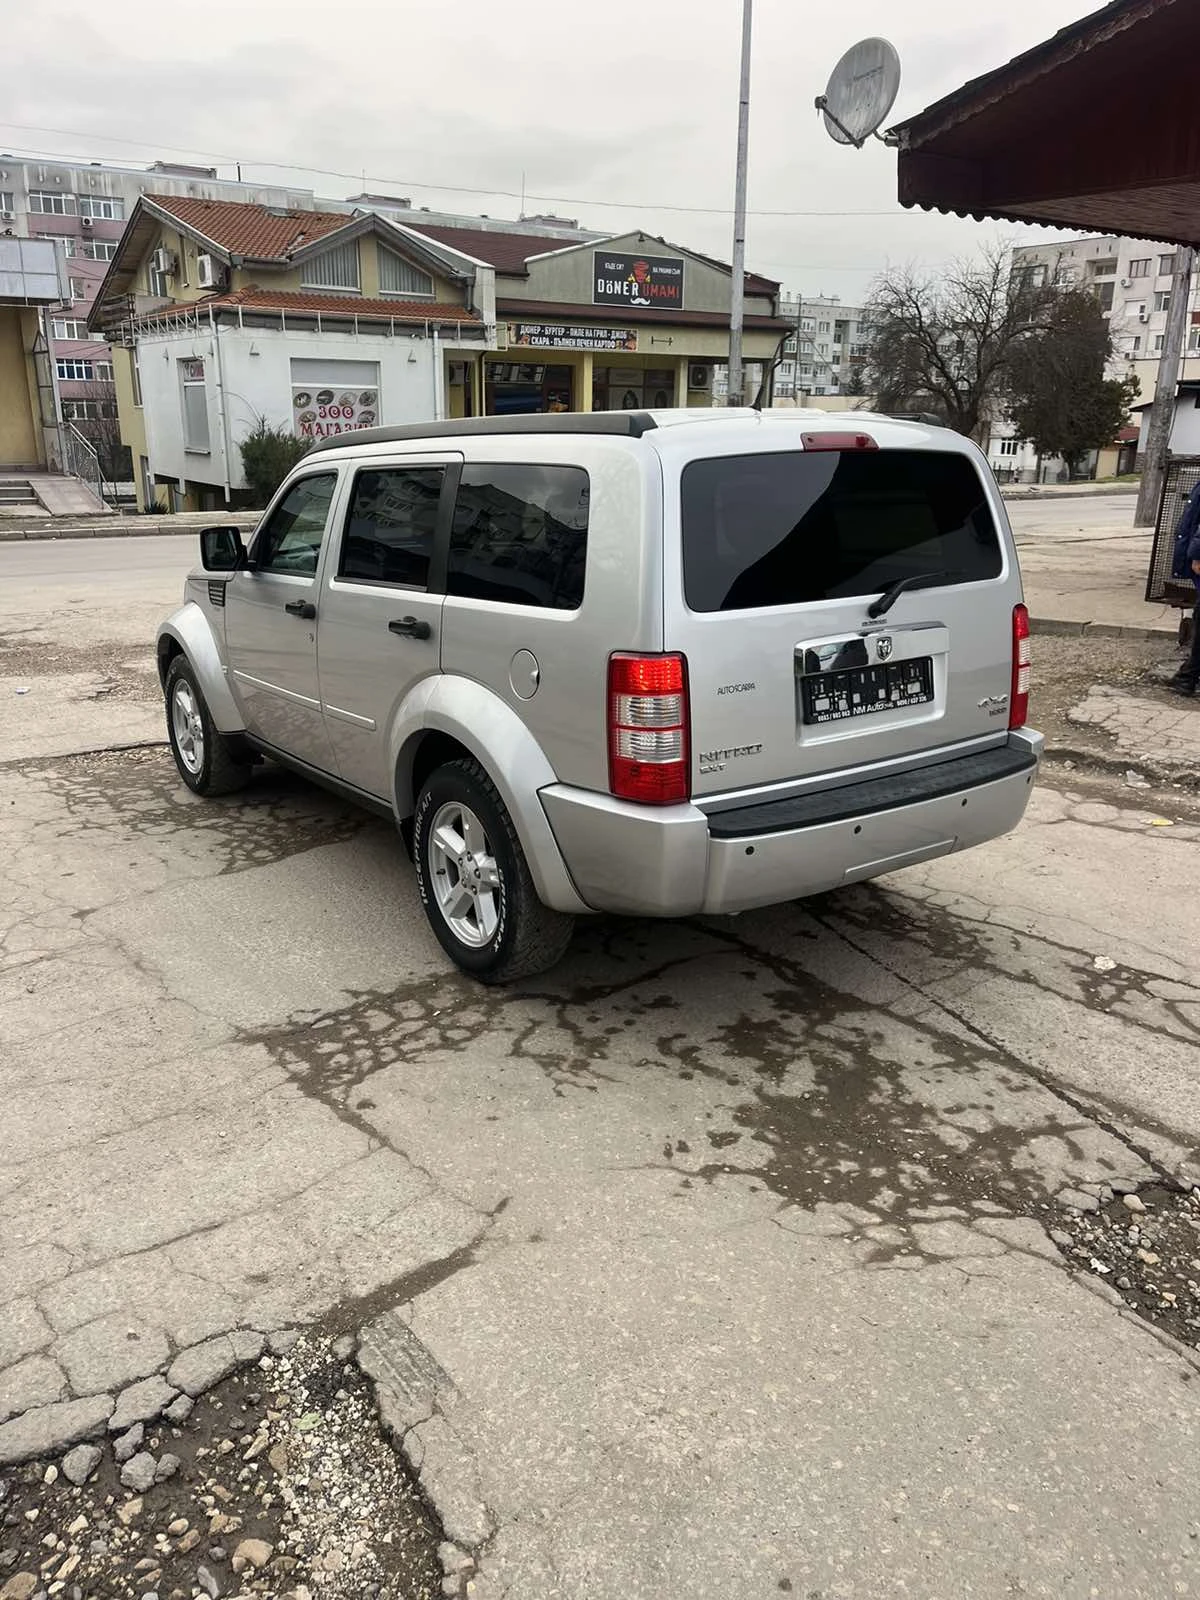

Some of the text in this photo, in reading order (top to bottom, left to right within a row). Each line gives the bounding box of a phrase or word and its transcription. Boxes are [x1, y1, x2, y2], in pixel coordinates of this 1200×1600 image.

[643, 283, 680, 298] UMAMI
[520, 325, 541, 335] ДЮНЕР
[544, 326, 565, 336] БУРГЕР
[569, 327, 585, 337] ПИЛЕ
[585, 328, 593, 338] НА
[593, 328, 607, 338] ГРИЛ
[531, 336, 550, 345] СКАРА
[553, 337, 576, 347] ПЪЛНЕН
[576, 338, 593, 347] ПЕЧЕН
[594, 339, 616, 348] КАРТОФ
[319, 405, 354, 419] ЗОО
[699, 743, 763, 763] NITRO
[414, 810, 429, 905] INCEPTION
